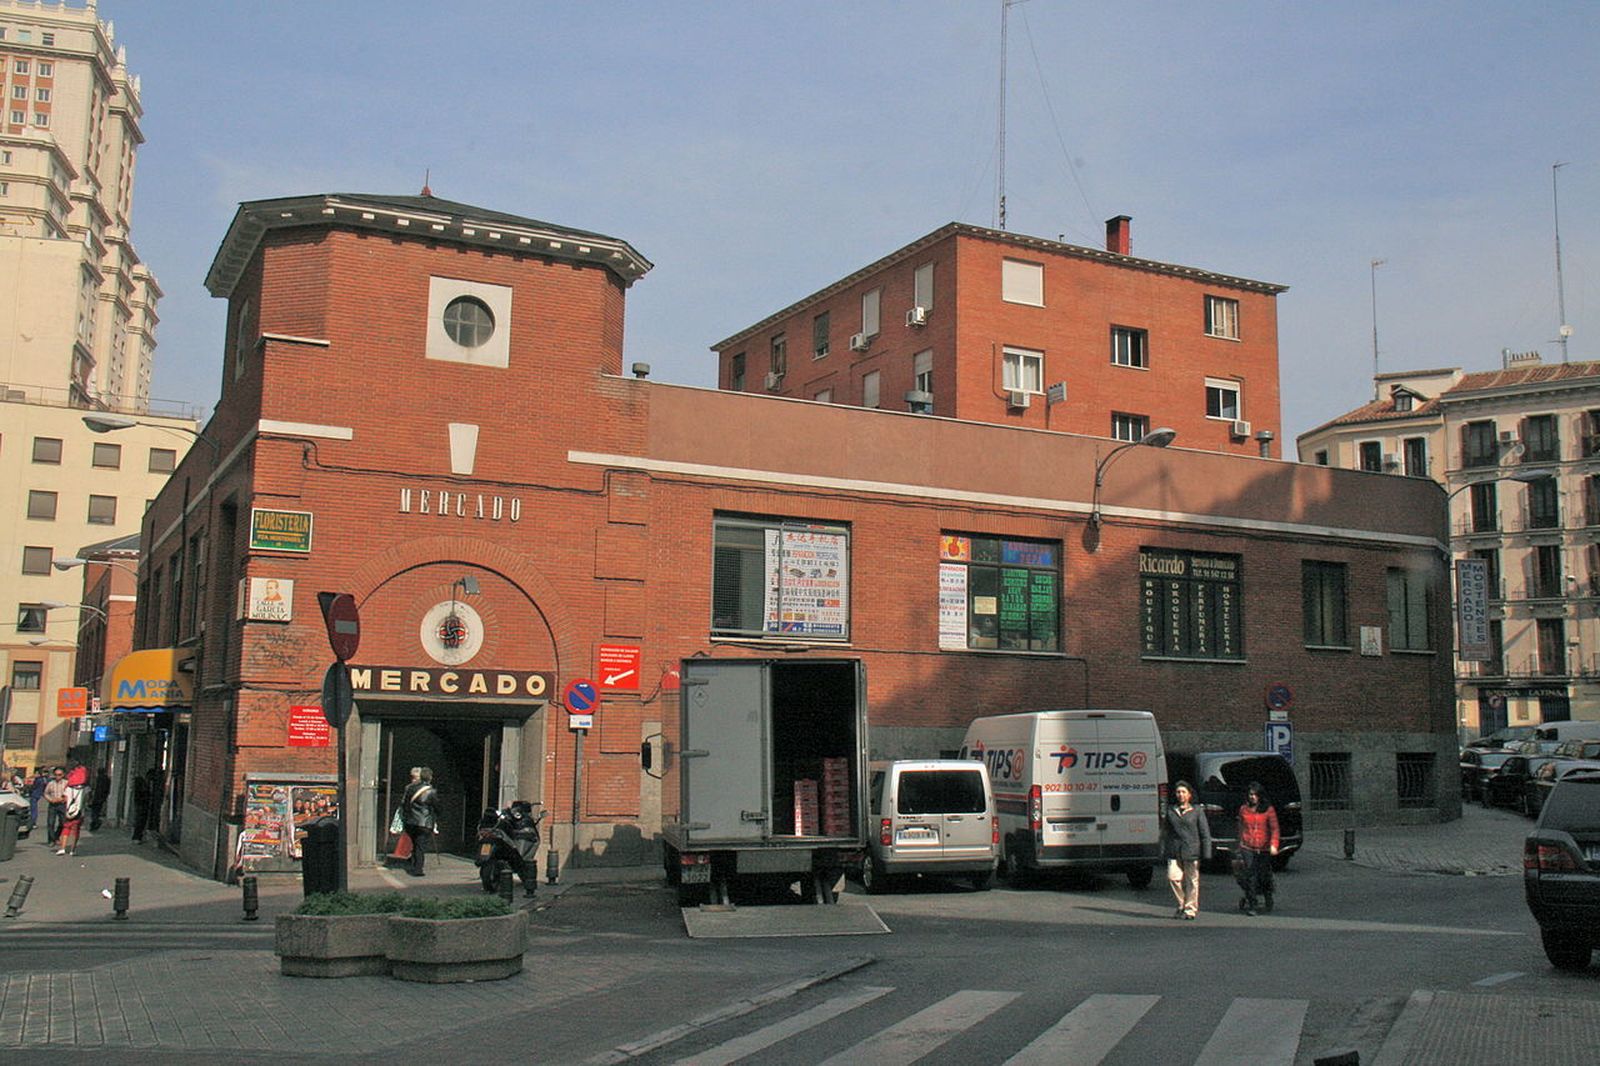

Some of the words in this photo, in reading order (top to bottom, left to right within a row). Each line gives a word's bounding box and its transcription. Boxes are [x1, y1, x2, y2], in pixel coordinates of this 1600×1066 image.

[399, 488, 521, 521] MERCADO
[255, 511, 309, 532] FLORISTERIA
[1139, 552, 1185, 575] Ricardo
[1461, 563, 1474, 621] MERCADO
[1473, 565, 1485, 642] MOSTENSES
[1198, 585, 1206, 652] PERFUMERIA
[351, 668, 546, 696] MERCADO
[1273, 725, 1291, 752] P
[1084, 751, 1148, 769] TIPS@
[1044, 783, 1060, 791] 902
[1063, 783, 1073, 791] 10
[1075, 783, 1085, 791] 10
